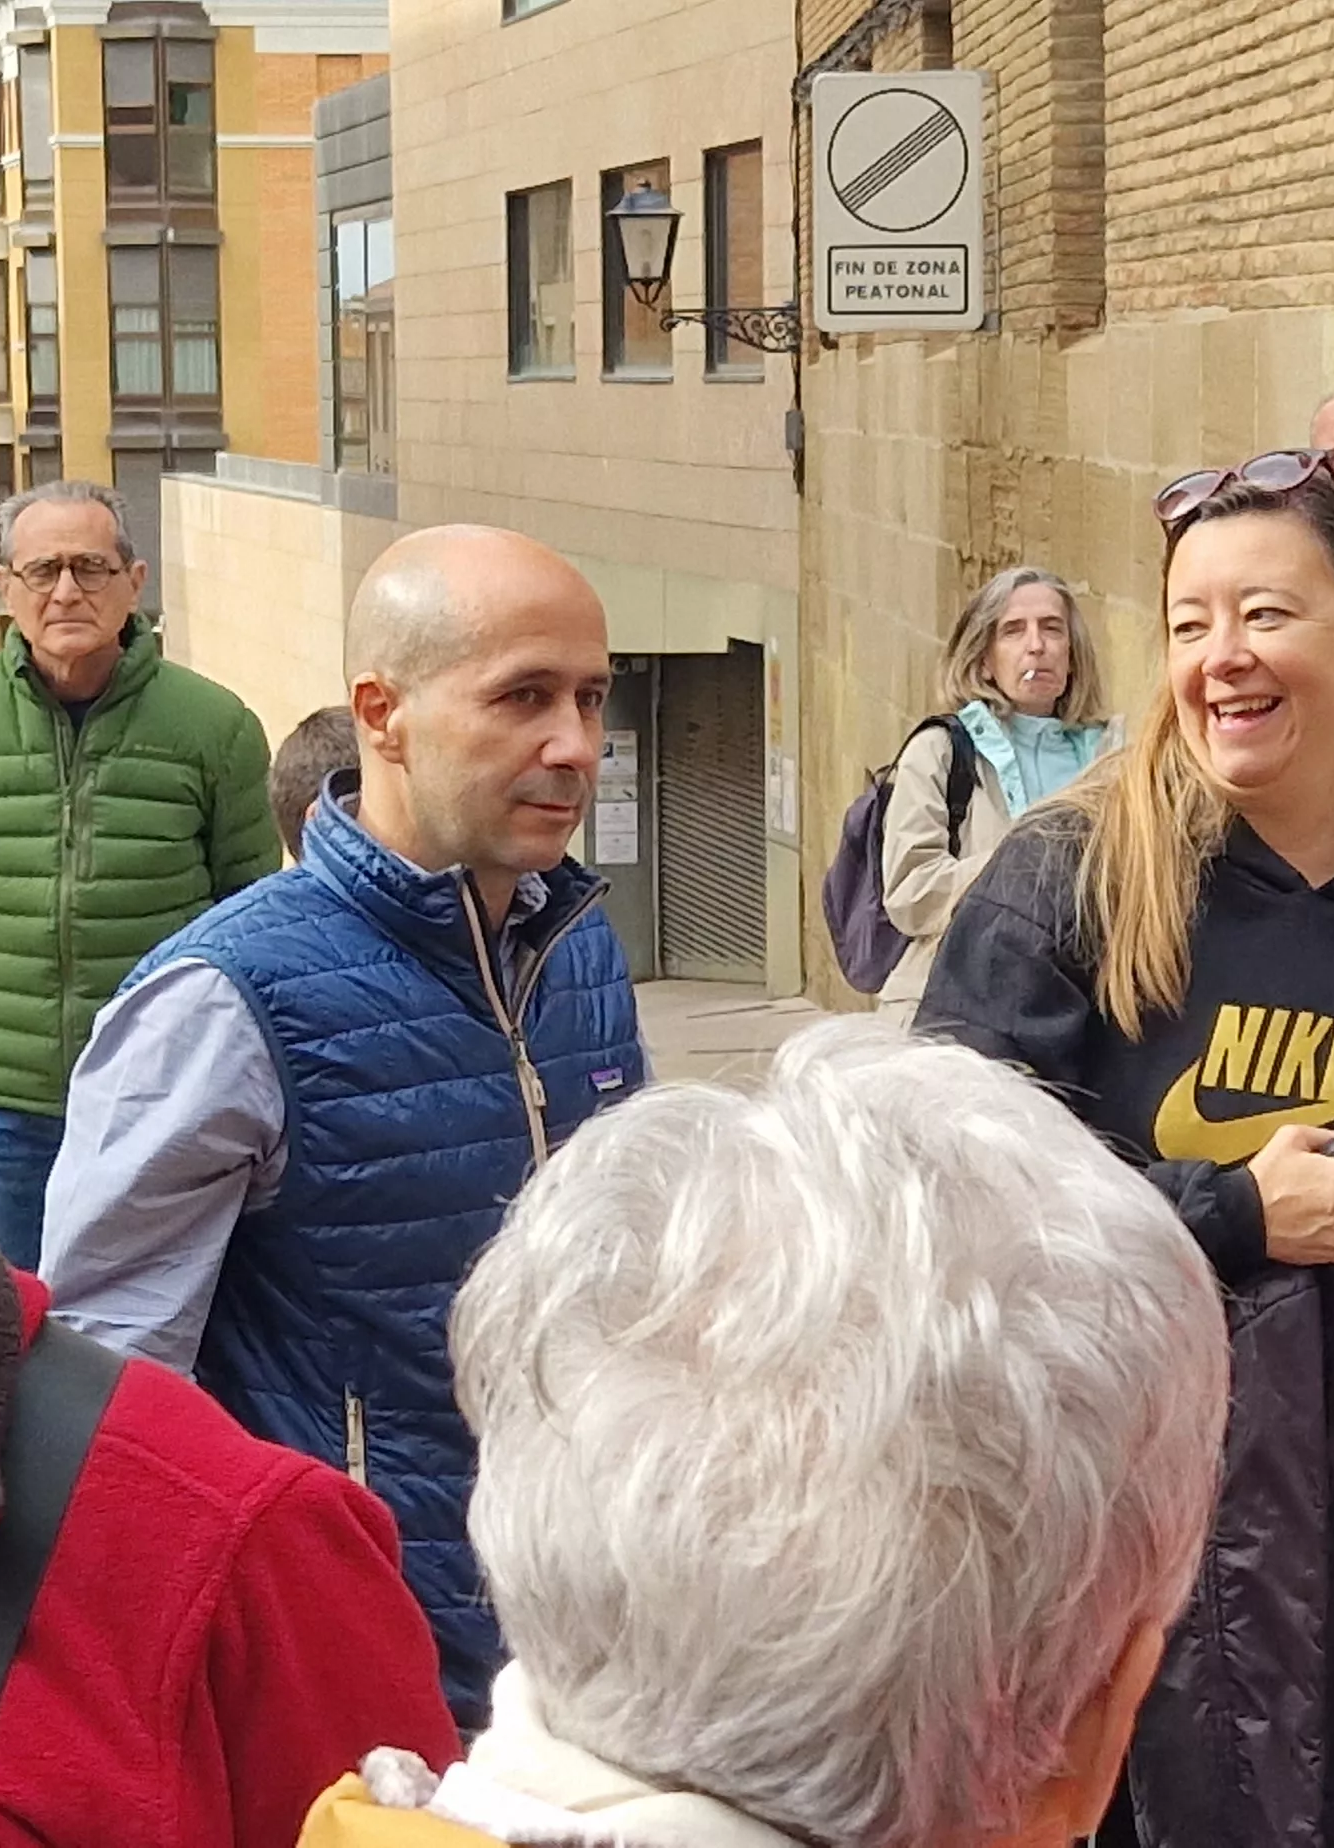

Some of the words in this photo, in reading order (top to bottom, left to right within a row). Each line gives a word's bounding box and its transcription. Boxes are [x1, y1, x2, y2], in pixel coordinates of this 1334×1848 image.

[835, 261, 865, 275] FIN
[873, 261, 897, 275] DE
[906, 261, 961, 275] ZONA
[845, 285, 949, 298] PEATONAL
